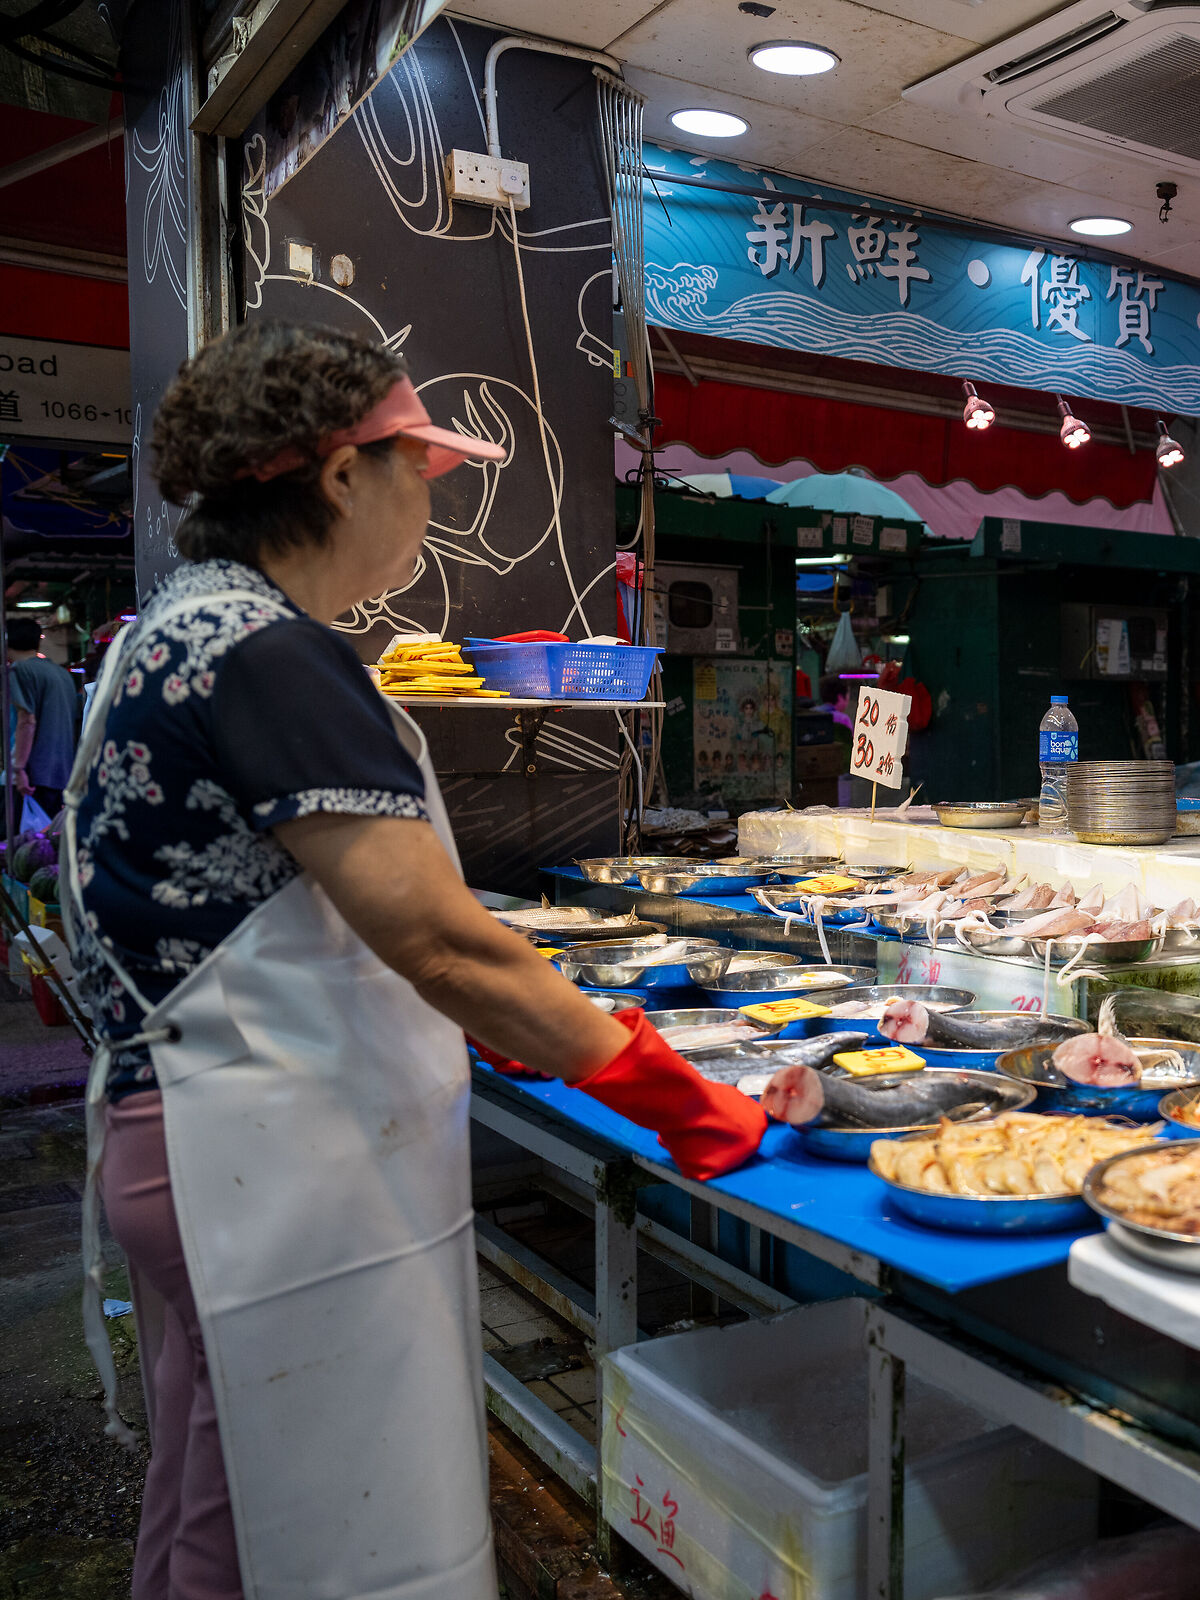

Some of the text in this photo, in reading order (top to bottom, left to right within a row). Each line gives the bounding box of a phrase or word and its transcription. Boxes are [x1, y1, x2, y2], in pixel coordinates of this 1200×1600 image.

[746, 177, 931, 305] 新鮮
[1021, 247, 1164, 354] 優質
[859, 695, 880, 727] 20
[854, 733, 874, 769] 30
